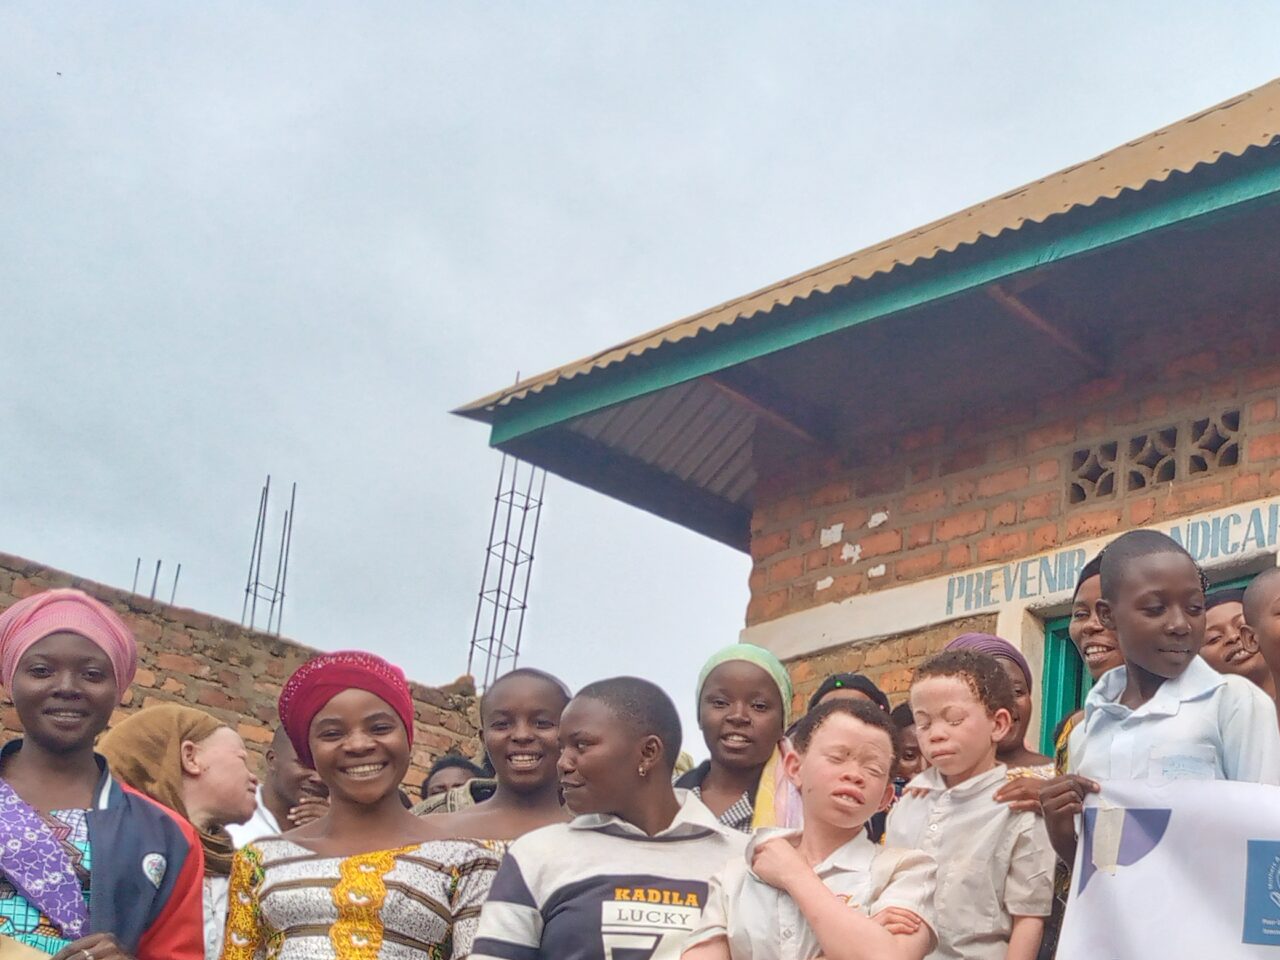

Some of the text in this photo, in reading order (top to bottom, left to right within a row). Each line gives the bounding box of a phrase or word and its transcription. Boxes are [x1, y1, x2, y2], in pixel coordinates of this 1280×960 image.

[945, 547, 1087, 616] PREVENIR
[614, 887, 699, 907] KADILA
[616, 907, 691, 925] LUCKY
